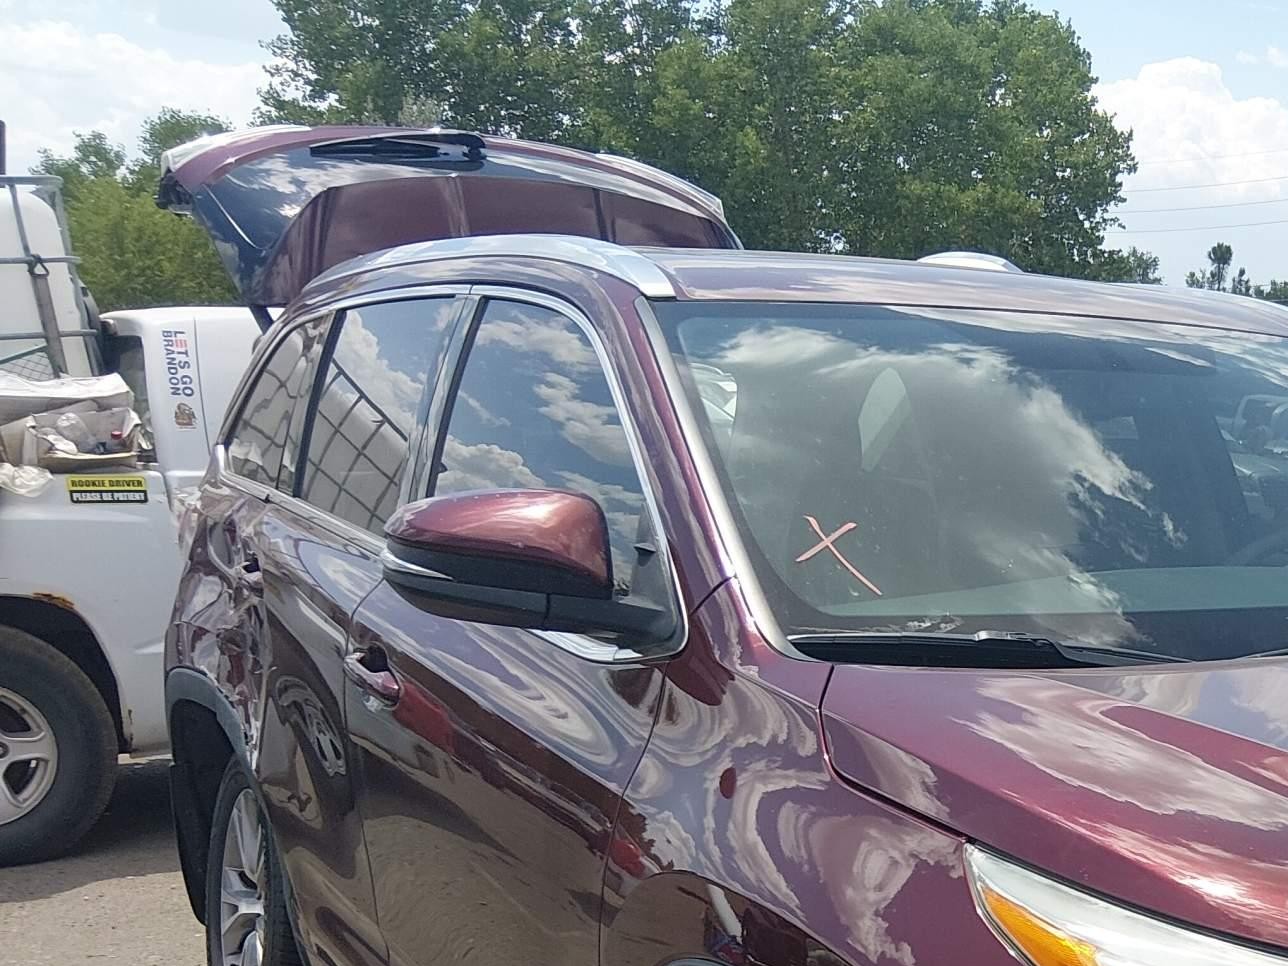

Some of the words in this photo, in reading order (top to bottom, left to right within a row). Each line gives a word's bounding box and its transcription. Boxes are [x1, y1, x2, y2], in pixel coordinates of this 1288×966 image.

[162, 330, 182, 396] BRANDON
[180, 374, 195, 397] GO
[71, 479, 107, 488] ROOKIE
[108, 479, 144, 488] DRIVER
